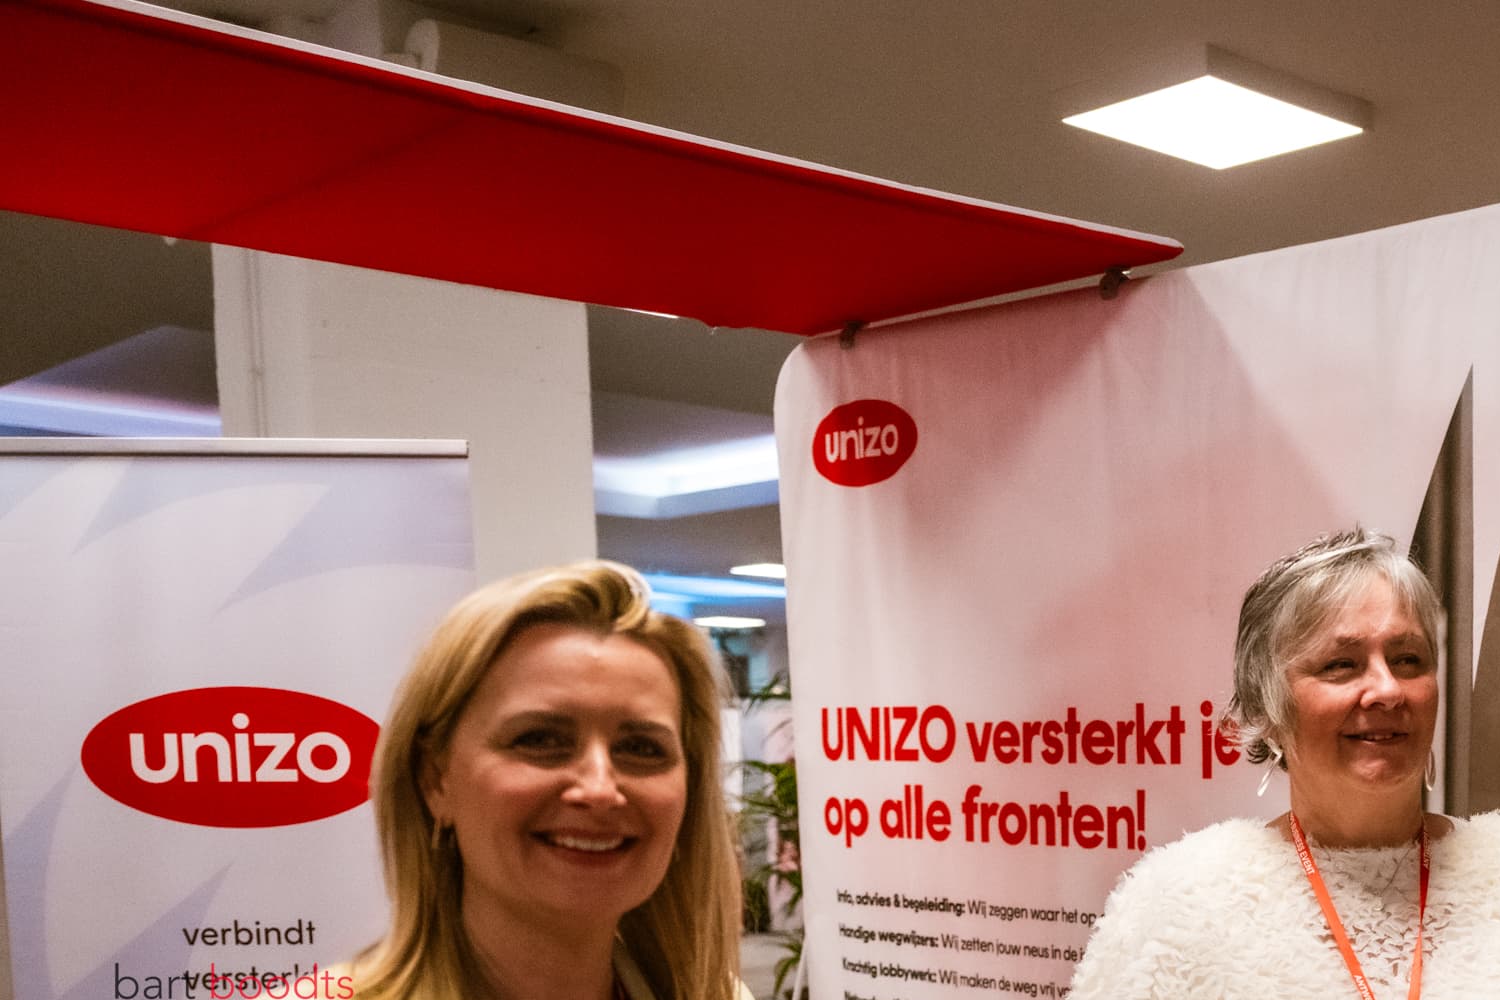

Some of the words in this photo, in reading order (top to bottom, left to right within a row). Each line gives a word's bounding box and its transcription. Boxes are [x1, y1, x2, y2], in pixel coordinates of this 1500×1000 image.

[824, 416, 899, 464] unizo
[129, 713, 351, 783] unizo
[821, 704, 956, 763] UNIZO
[966, 703, 1185, 765] versterkt
[824, 797, 869, 848] op
[880, 785, 951, 842] alle
[962, 785, 1146, 851] fronten!
[1299, 850, 1316, 875] EVENT
[856, 891, 891, 908] advies
[893, 893, 901, 908] &
[902, 895, 966, 916] begeleiding:
[967, 899, 987, 919] Wij
[989, 904, 1028, 921] zeggen
[1030, 908, 1060, 922] waar
[1061, 907, 1078, 924] het
[1080, 912, 1097, 928] op
[182, 919, 316, 946] verbindt
[878, 930, 939, 948] wegwijzers:
[941, 933, 960, 953] Wij
[961, 938, 994, 952] zetten
[996, 940, 1021, 958] jouw
[1023, 945, 1049, 959] neus
[1052, 944, 1061, 960] in
[1063, 946, 1078, 961] de
[939, 969, 959, 987] Wij
[960, 974, 996, 989] maken
[998, 976, 1011, 991] de
[1013, 981, 1037, 998] weg
[1040, 982, 1056, 1000] vrij
